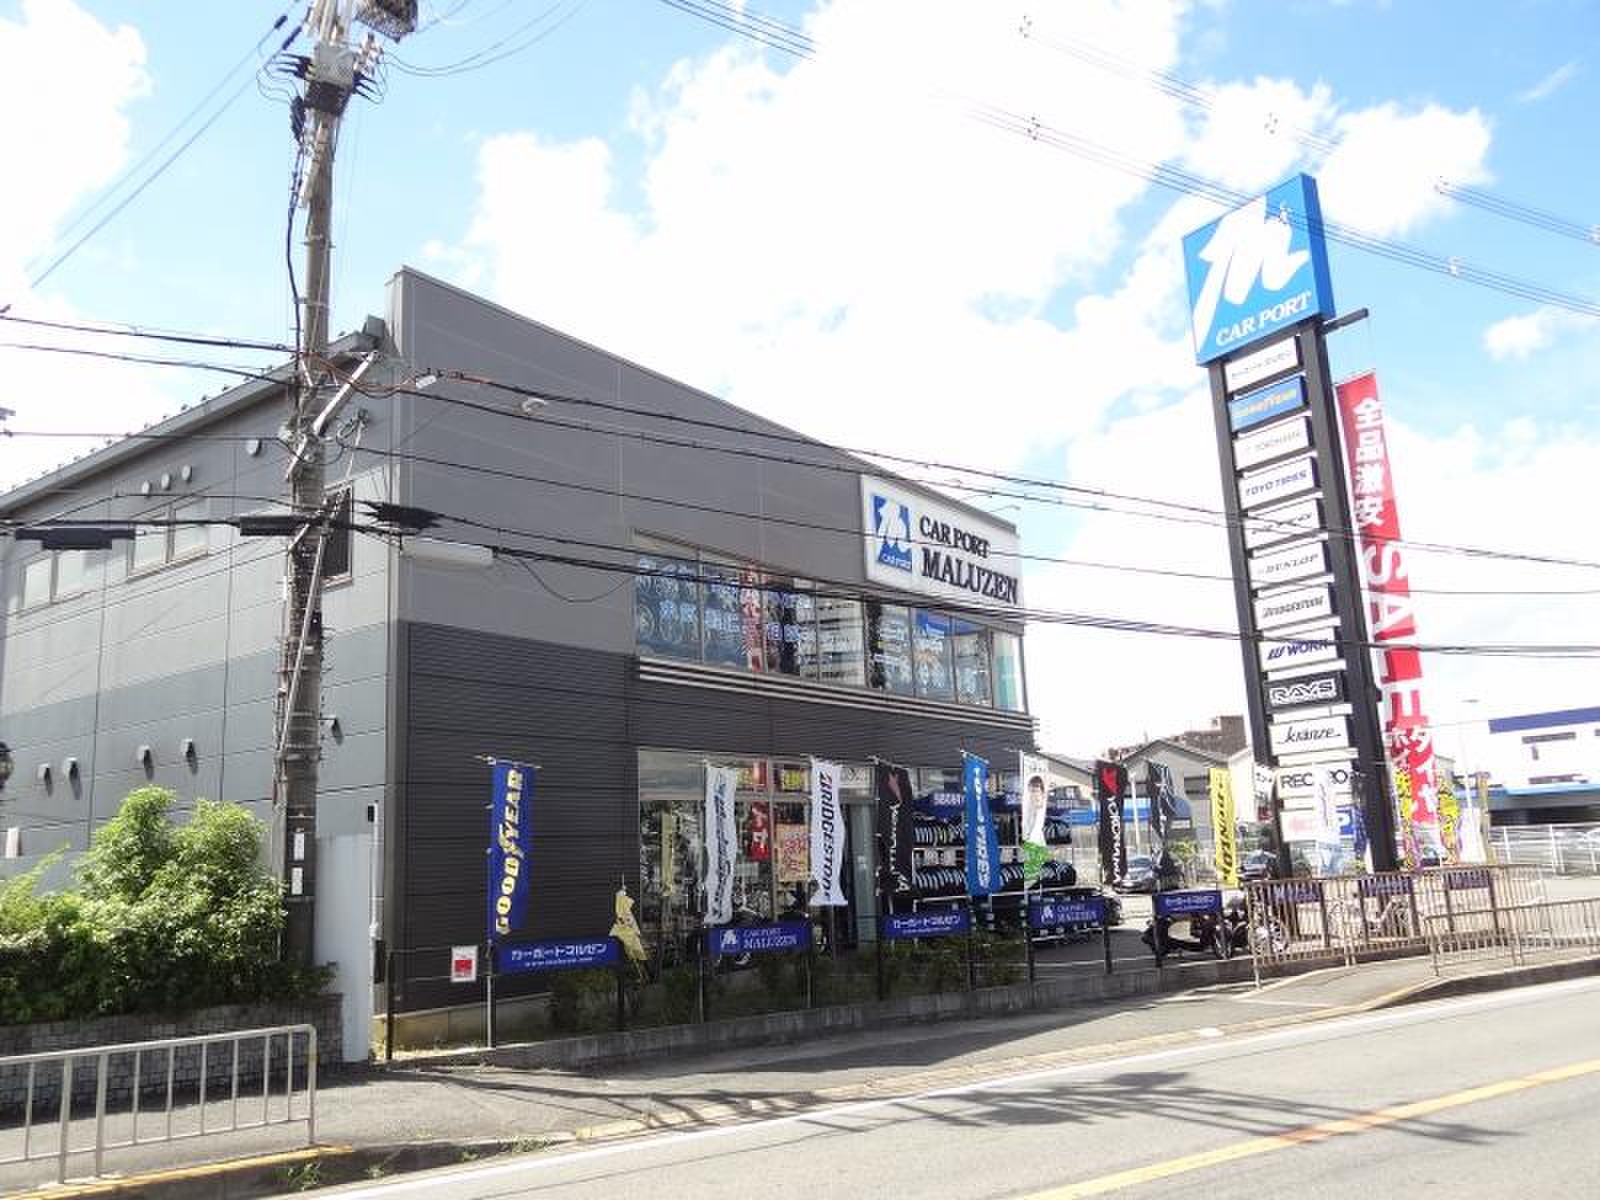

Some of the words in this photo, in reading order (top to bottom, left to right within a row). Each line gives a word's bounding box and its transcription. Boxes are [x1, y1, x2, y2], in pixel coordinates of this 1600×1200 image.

[1216, 316, 1257, 346] CAR
[1258, 291, 1313, 328] PORT
[919, 514, 952, 545] CAR
[952, 527, 991, 559] PORT
[920, 547, 1019, 605] MALUZEN
[1363, 541, 1428, 727] SALE
[1271, 680, 1337, 706] RAYS
[1280, 769, 1349, 789] RECO
[496, 769, 526, 935] GOODYEAR
